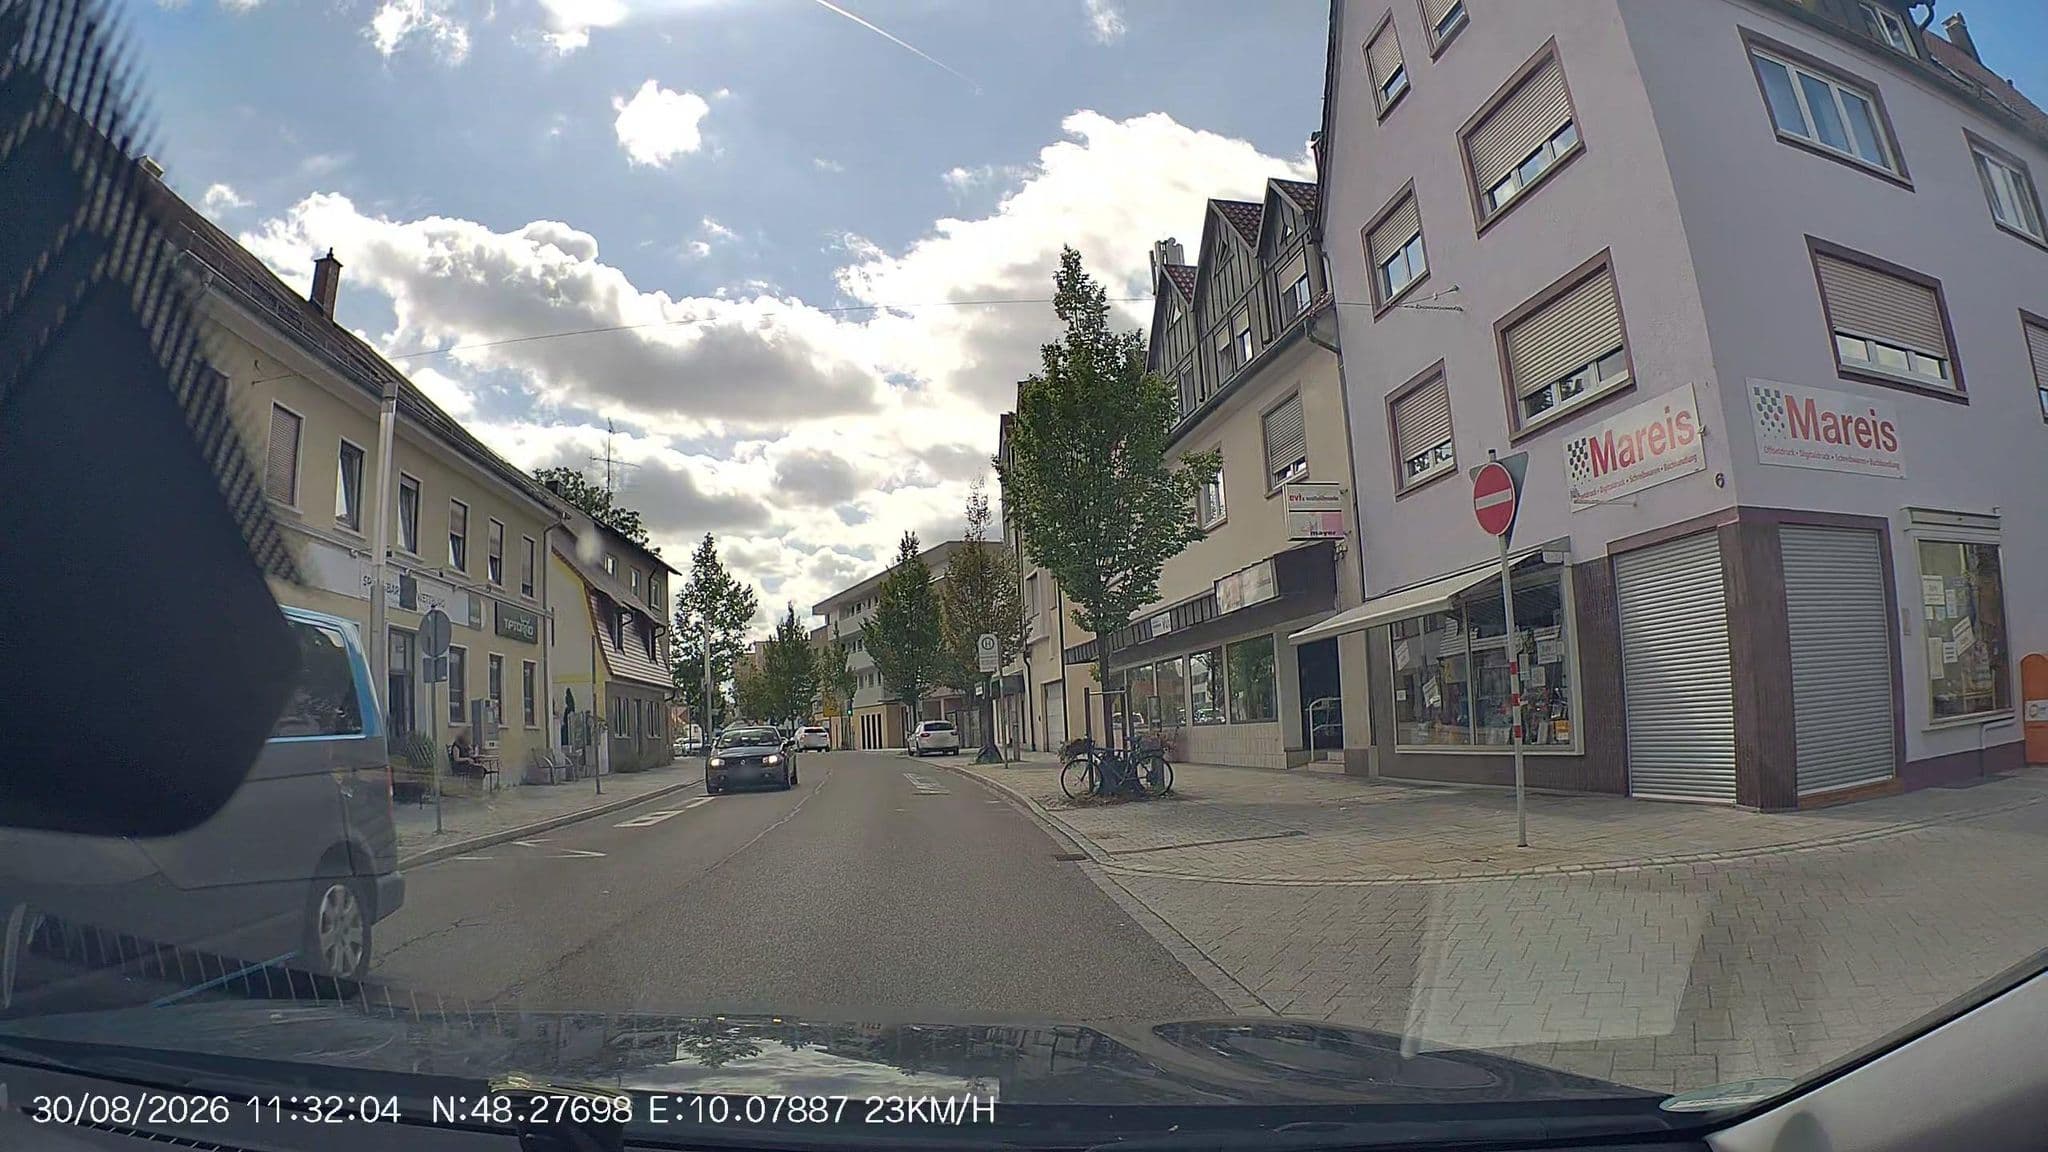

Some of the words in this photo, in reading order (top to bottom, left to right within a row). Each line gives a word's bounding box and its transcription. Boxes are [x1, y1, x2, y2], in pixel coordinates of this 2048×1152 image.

[1589, 405, 1695, 478] Mareis
[1784, 394, 1898, 452] Mareis
[1715, 472, 1725, 489] 6
